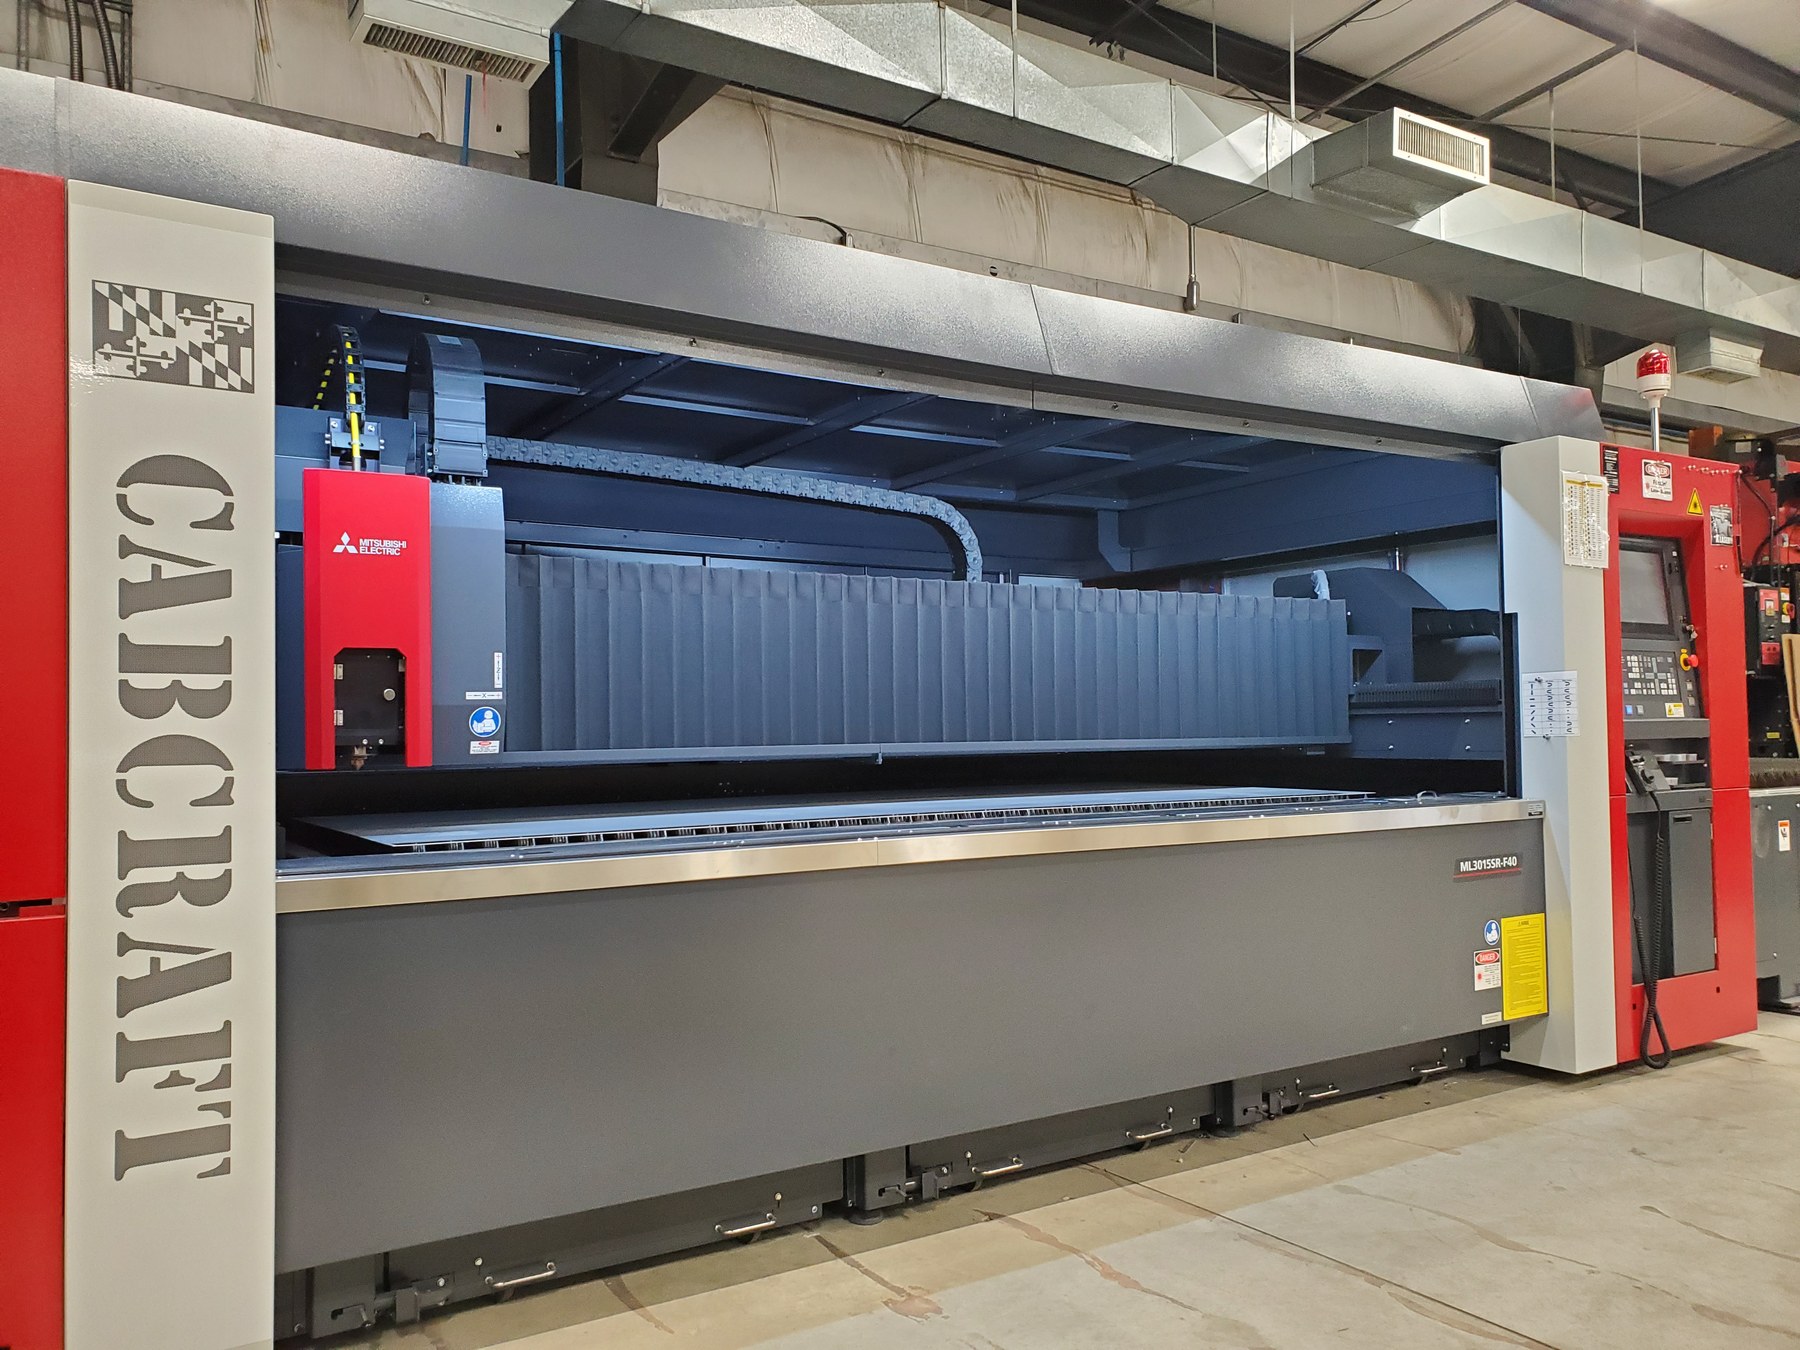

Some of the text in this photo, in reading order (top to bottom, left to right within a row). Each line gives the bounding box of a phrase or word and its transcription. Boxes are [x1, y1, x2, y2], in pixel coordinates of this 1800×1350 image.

[359, 538, 407, 549] MITSUBISHI
[359, 546, 401, 556] ELECTRIC
[115, 454, 235, 1182] CABCRAFT
[1460, 856, 1518, 872] ML3015SR-F40
